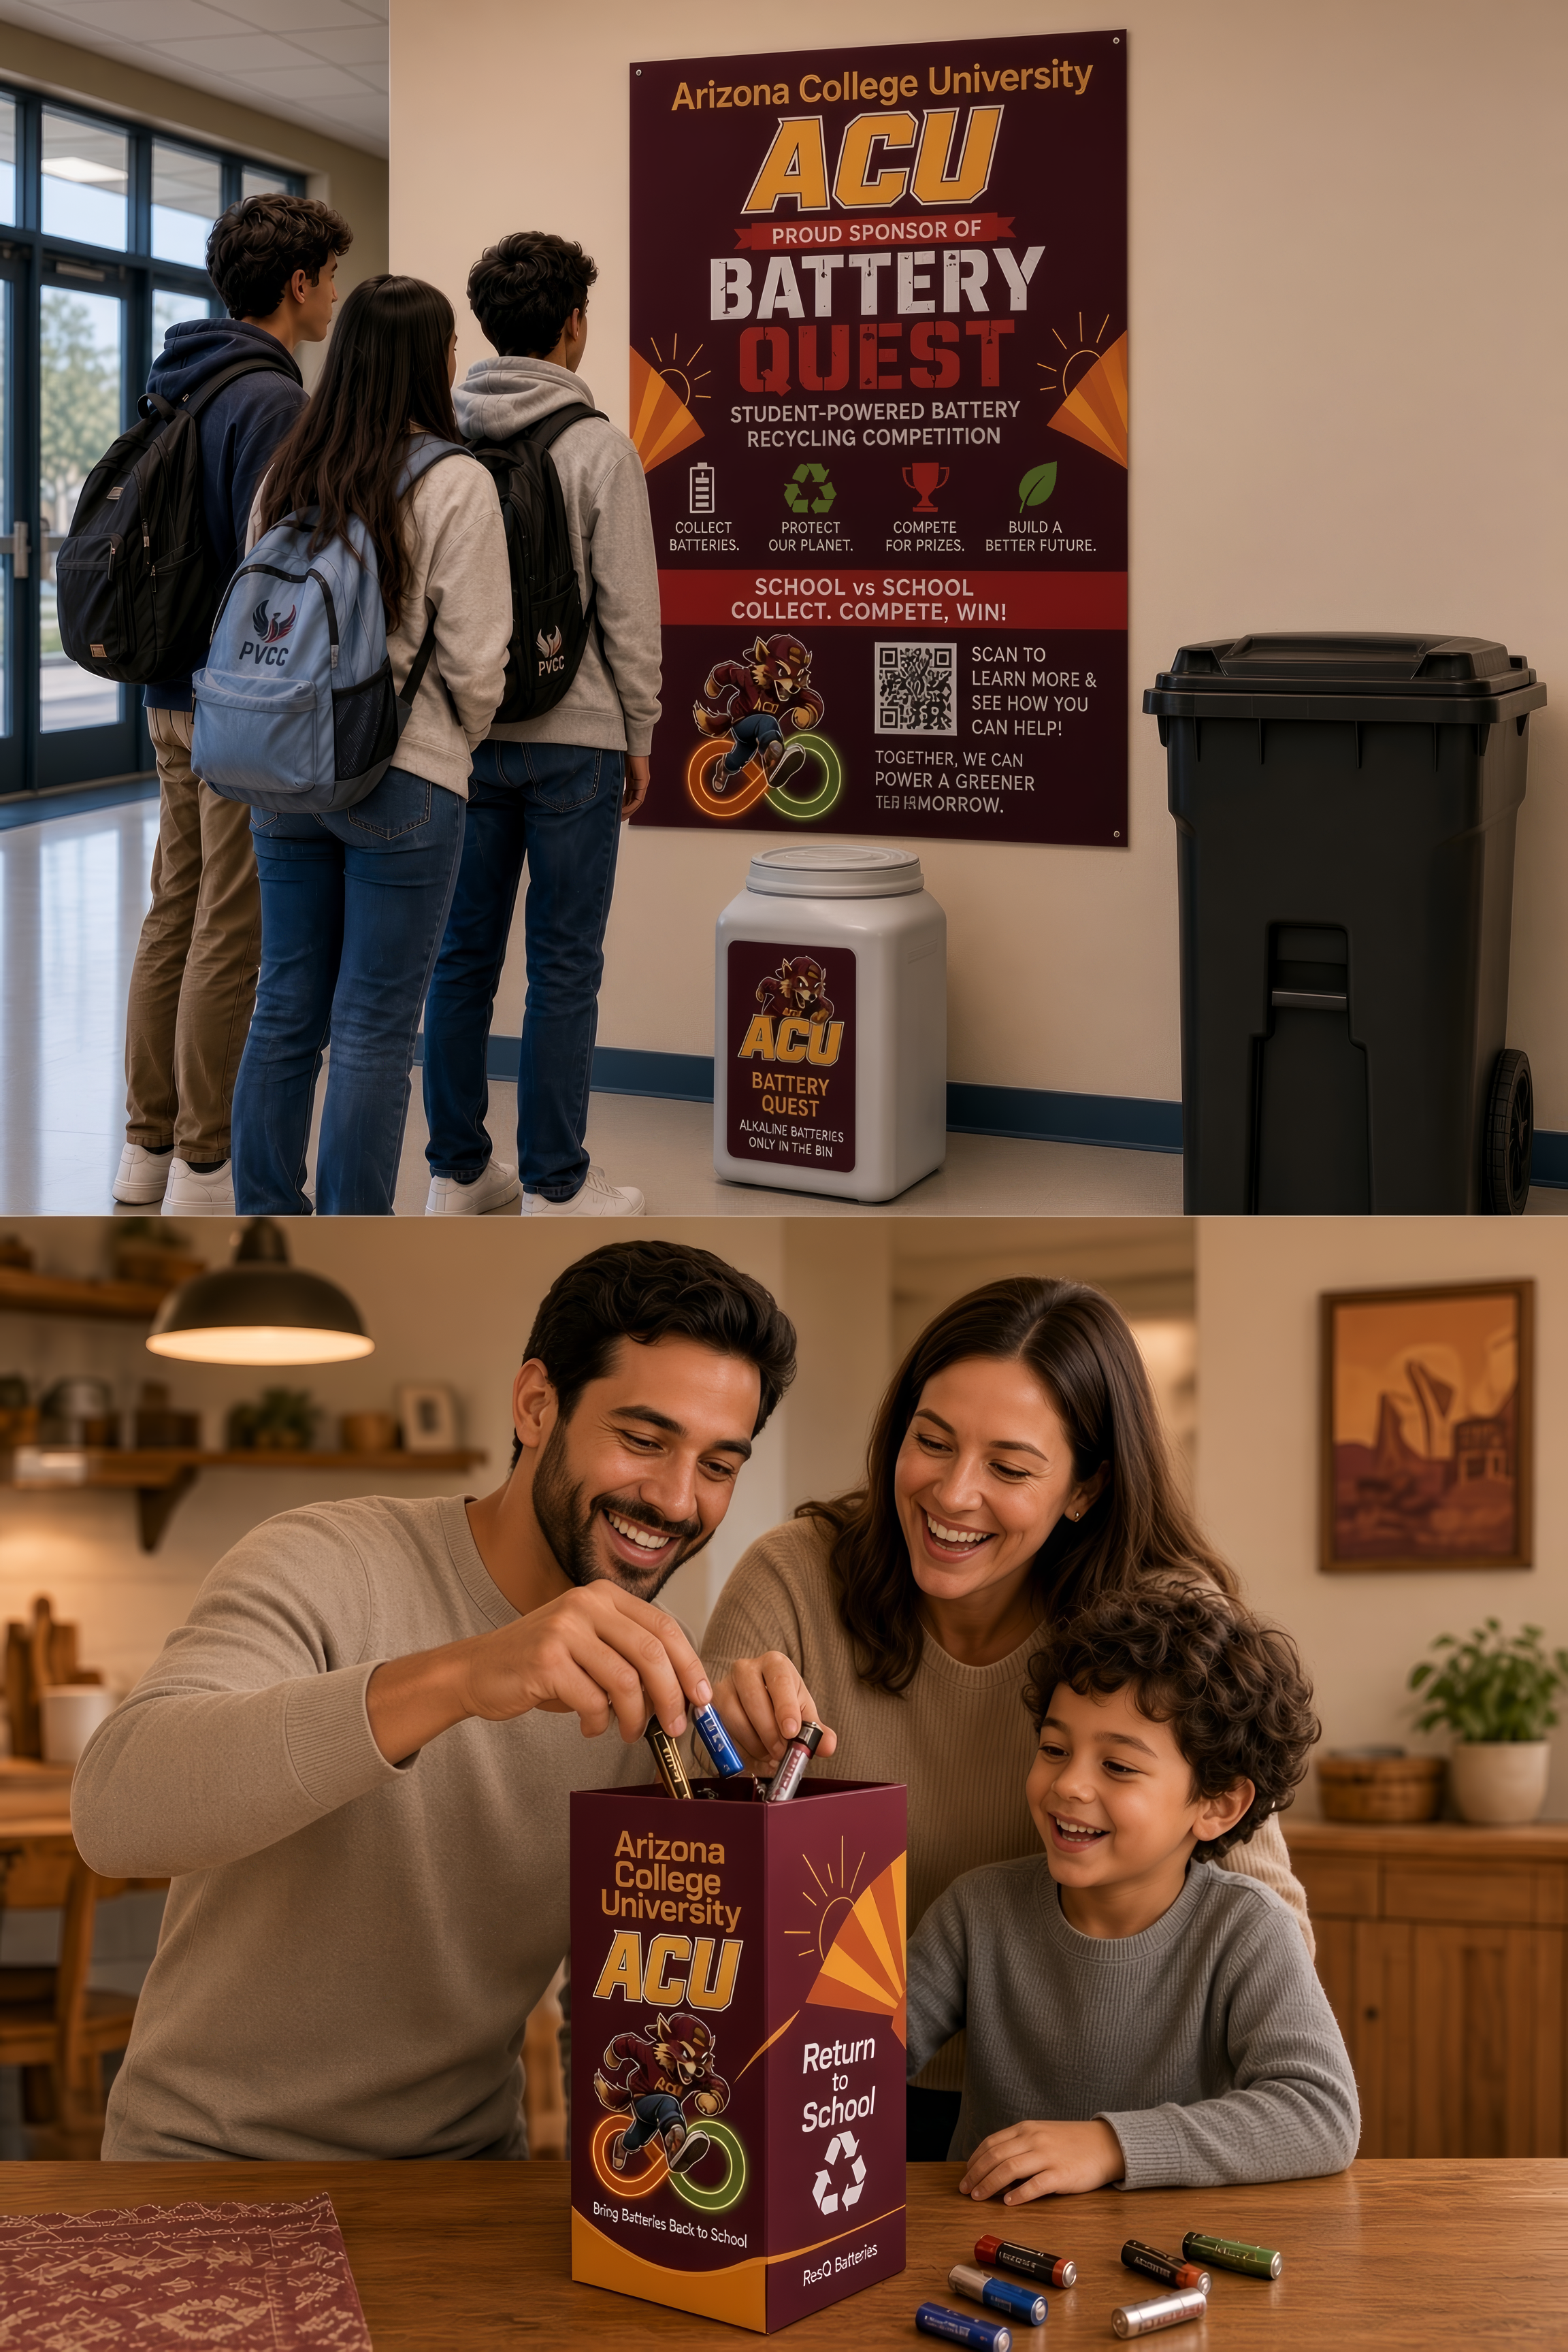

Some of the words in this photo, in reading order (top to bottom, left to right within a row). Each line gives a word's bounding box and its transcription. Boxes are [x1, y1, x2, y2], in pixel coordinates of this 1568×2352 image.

[671, 80, 789, 110] Arizona
[800, 71, 918, 105] College
[930, 59, 1093, 95] University
[741, 105, 1004, 214] ACU
[772, 226, 843, 245] PROUD
[849, 222, 947, 242] SPONSOR
[954, 220, 981, 238] OF
[710, 246, 1045, 321] BATTERY
[740, 319, 1015, 397] QUEST
[730, 403, 925, 423] STUDENT-POWERED
[932, 401, 1020, 420] BATTERY
[748, 430, 856, 448] RECYCLING
[862, 427, 1000, 445] COMPETITION
[676, 522, 732, 534] COLLECT
[782, 522, 840, 534] PROTECT
[894, 521, 957, 534] COMPETE
[1009, 521, 1048, 533] BUILD
[1052, 521, 1062, 533] A
[670, 539, 739, 551] BATTERIES.
[769, 539, 796, 551] OUR
[801, 539, 853, 551] PLANET.
[886, 539, 911, 551] FOR
[917, 539, 964, 551] PRIZES.
[986, 539, 1035, 551] BETTER
[1041, 539, 1096, 551] FUTURE.
[755, 578, 846, 596] SCHOOL
[853, 582, 875, 595] vs
[883, 578, 974, 596] SCHOOL
[731, 602, 832, 619] COLLECT.
[839, 602, 949, 623] COMPETE,
[956, 603, 1007, 621] WIN!
[239, 641, 289, 666] PVCC
[972, 647, 1017, 662] SCAN
[1023, 647, 1045, 662] TO
[538, 655, 565, 676] PVCC
[972, 672, 1025, 687] LEARN
[1032, 672, 1079, 687] MORE
[1085, 673, 1097, 687] &
[972, 696, 1001, 711] SEE
[1008, 696, 1049, 712] HOW
[1054, 697, 1088, 713] YOU
[972, 720, 1007, 735] CAN
[1014, 720, 1062, 736] HELP!
[875, 751, 958, 768] TOGETHER,
[963, 752, 986, 766] WE
[992, 753, 1022, 767] CAN
[876, 771, 932, 788] POWER
[938, 773, 949, 788] A
[956, 774, 1034, 791] GREENER
[738, 1014, 845, 1066] ACU
[752, 1071, 830, 1096] BATTERY
[762, 1095, 819, 1117] QUEST
[740, 1119, 787, 1136] ALKALINE
[791, 1126, 844, 1143] BATTERIES
[749, 1137, 776, 1150] ONLY
[779, 1141, 789, 1152] IN
[792, 1143, 811, 1154] THE
[816, 1145, 832, 1158] BIN
[615, 1831, 725, 1864] Arizona
[615, 1861, 721, 1898] College
[601, 1889, 742, 1933] University
[593, 1930, 743, 2012] ACU
[802, 2038, 875, 2074] Return
[832, 2073, 848, 2091] to
[802, 2086, 876, 2133] School
[622, 2208, 666, 2230] Batteries
[670, 2219, 695, 2236] Back
[697, 2225, 708, 2239] to
[710, 2228, 747, 2248] School
[803, 2260, 832, 2286] ResQ
[834, 2244, 878, 2274] Batteries
